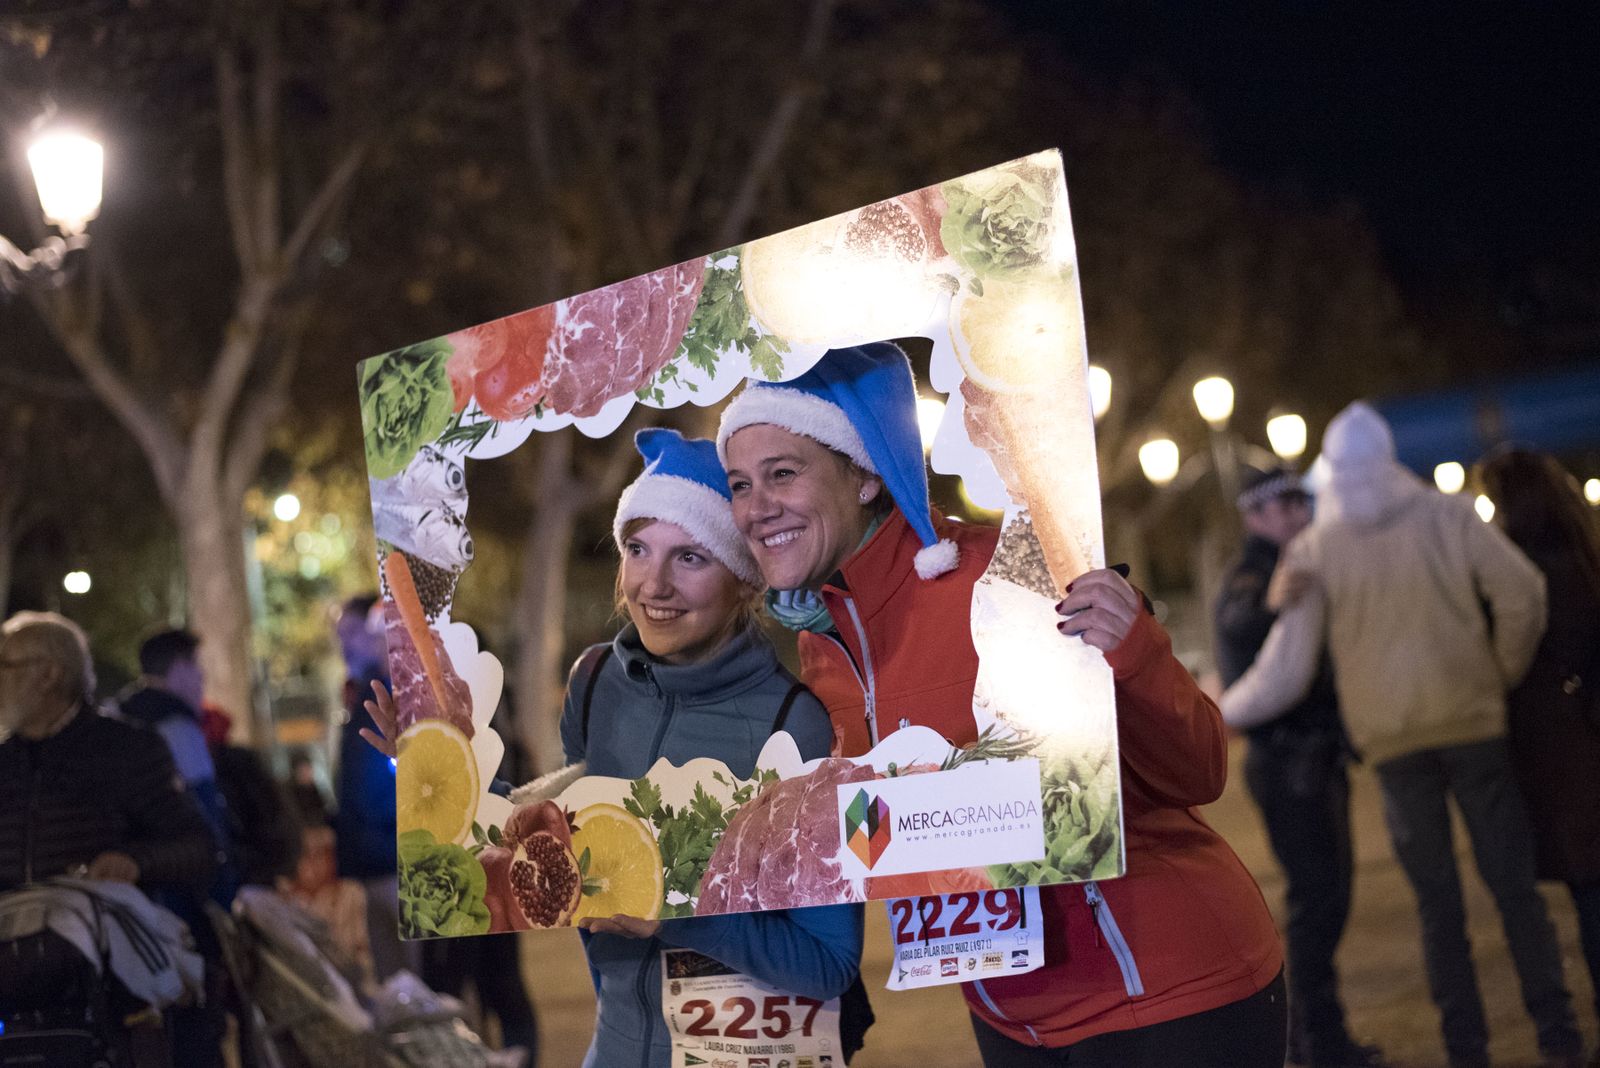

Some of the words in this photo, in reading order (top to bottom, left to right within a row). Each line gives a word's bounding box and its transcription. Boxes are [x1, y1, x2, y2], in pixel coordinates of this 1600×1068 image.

[898, 799, 1038, 832] MERCAGRANADA
[906, 823, 1031, 842] www.mercagranada.es
[891, 889, 1021, 945] 2229
[914, 948, 923, 959] DEL
[924, 945, 940, 957] PILAR
[941, 943, 954, 956] RUIZ
[955, 942, 969, 953] RUIZ
[680, 996, 825, 1039] 2257
[704, 1041, 724, 1052] LAURA
[725, 1043, 742, 1055] CRUZ
[743, 1045, 774, 1055] NAVARRO
